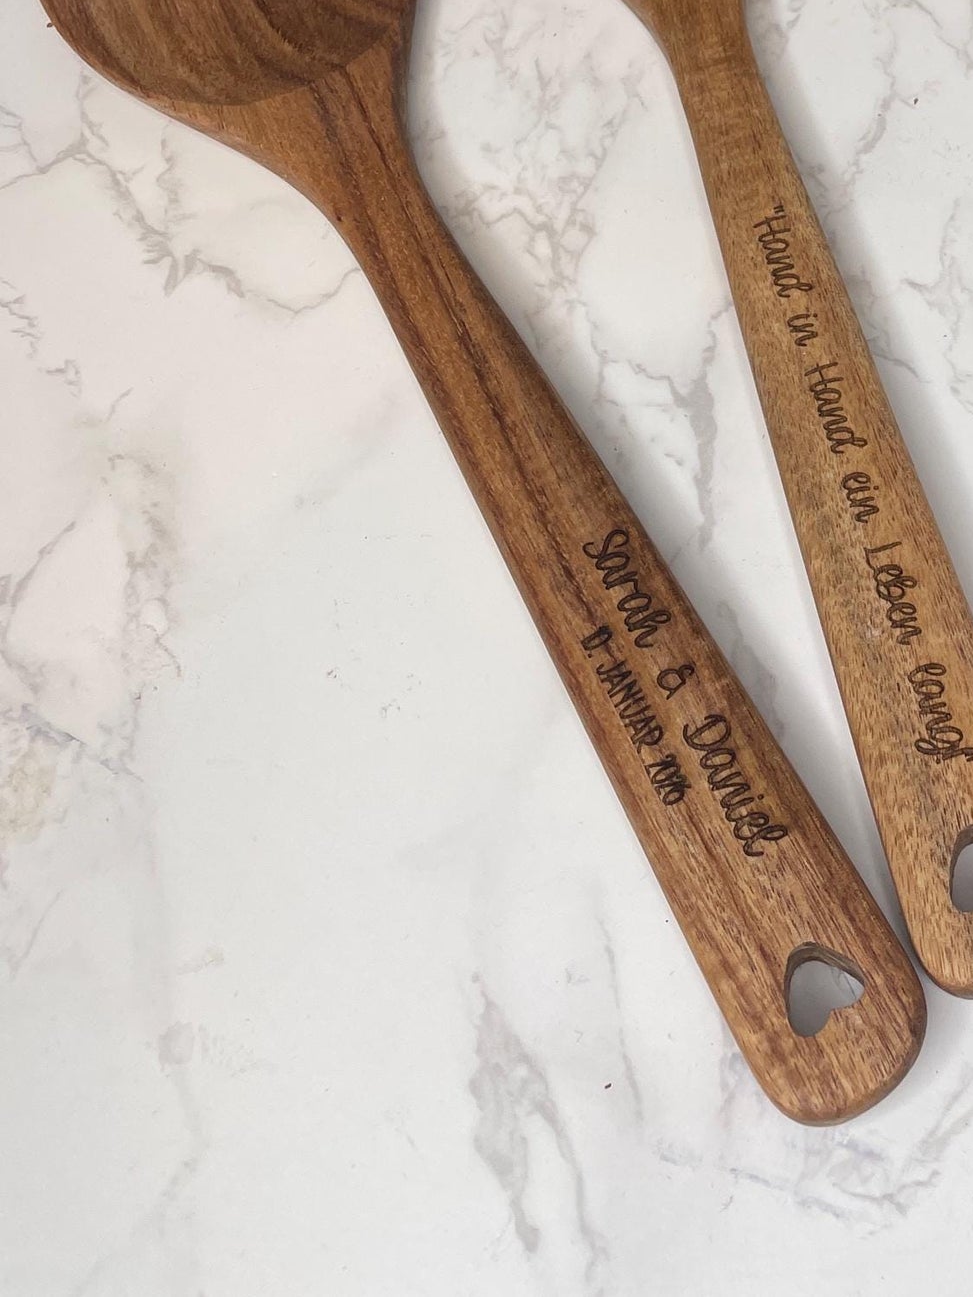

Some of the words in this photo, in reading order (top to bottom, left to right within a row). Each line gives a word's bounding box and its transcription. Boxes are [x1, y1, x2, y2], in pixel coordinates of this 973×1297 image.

[787, 313, 818, 347] in
[804, 361, 868, 454] Hand
[840, 471, 879, 523] ein
[864, 541, 922, 645] Leben
[583, 529, 672, 649] Sarah
[657, 664, 695, 701] &
[683, 714, 788, 857] Daniel
[596, 659, 663, 754] JANUAR
